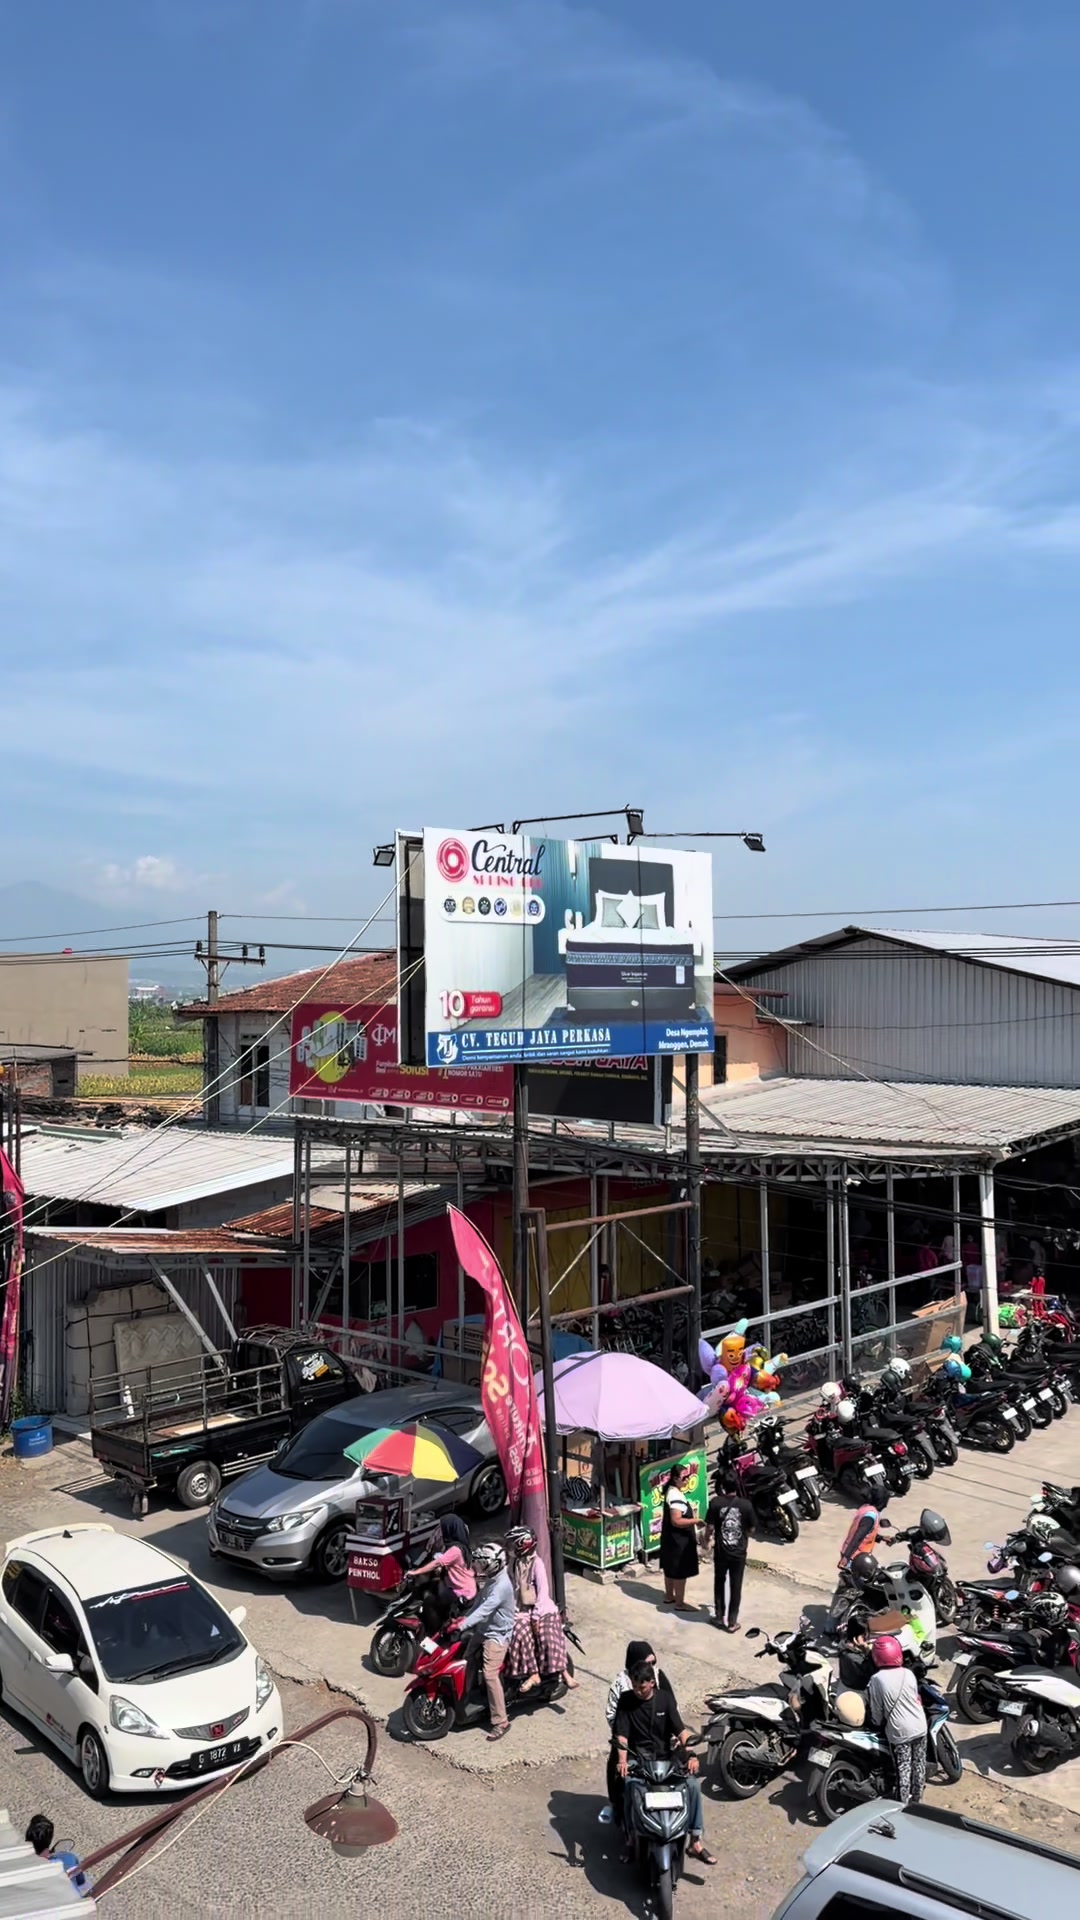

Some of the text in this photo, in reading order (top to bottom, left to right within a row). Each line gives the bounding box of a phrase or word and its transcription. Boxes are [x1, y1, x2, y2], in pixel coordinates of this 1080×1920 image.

[471, 839, 546, 876] Central
[439, 990, 492, 1018] 10 Tahun
[461, 1028, 611, 1048] CV. TEGUH JAYA PERKASA
[665, 1028, 680, 1037] Desa
[353, 1556, 379, 1567] BAKSO
[348, 1567, 381, 1580] PENTHOL
